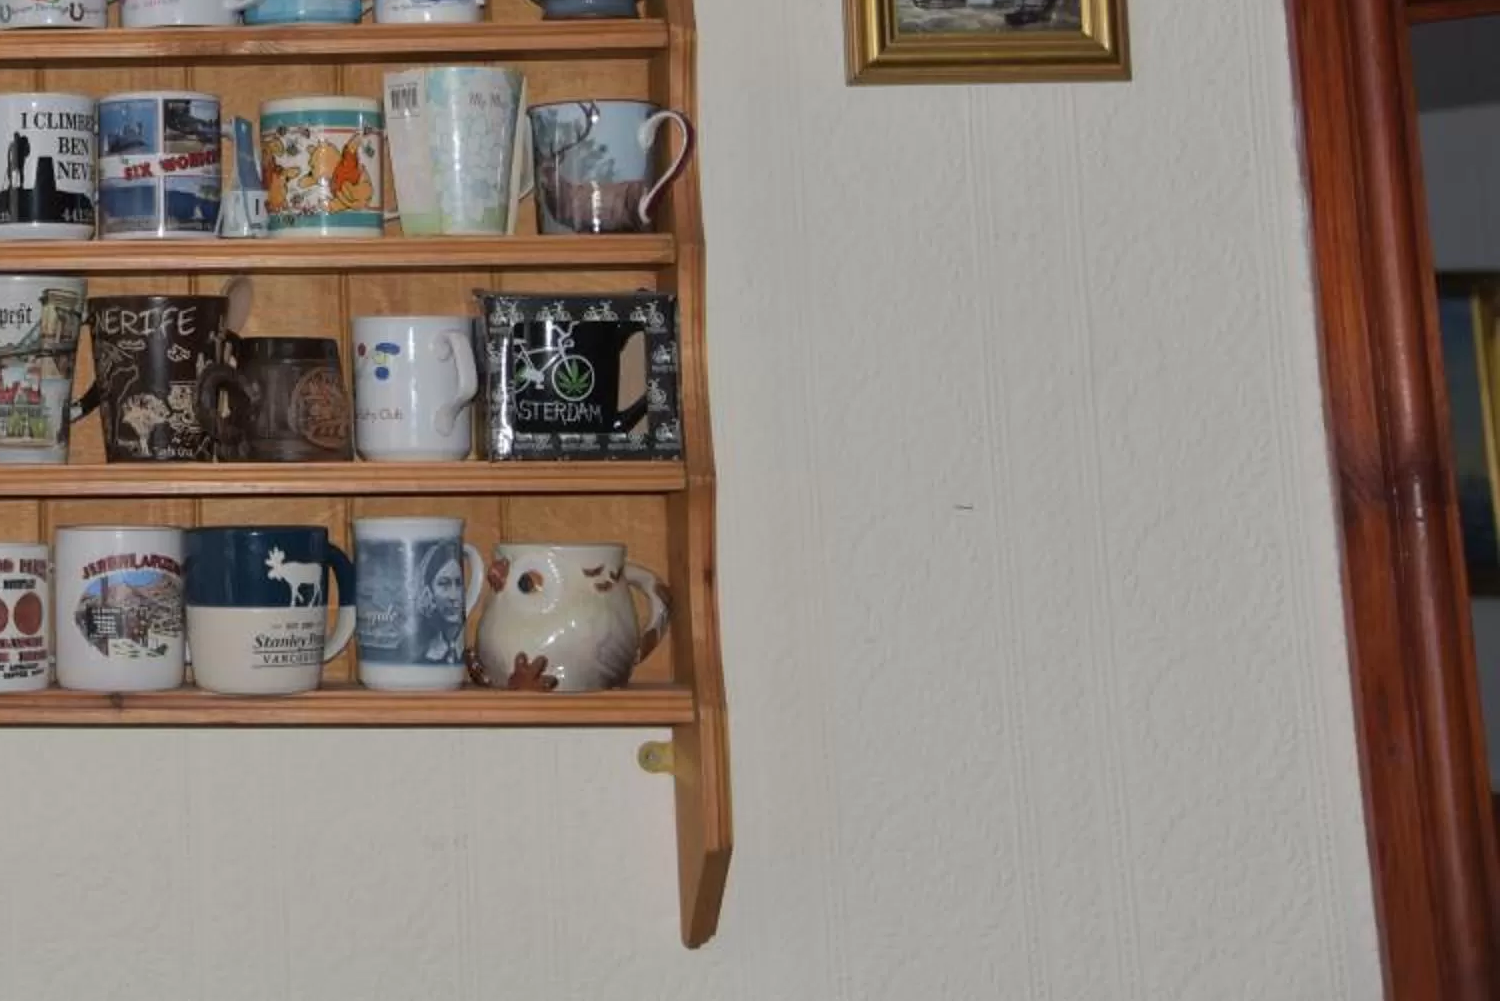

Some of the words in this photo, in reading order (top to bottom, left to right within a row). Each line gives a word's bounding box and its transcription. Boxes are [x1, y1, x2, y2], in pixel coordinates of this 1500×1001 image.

[33, 111, 98, 133] CLIMBE
[57, 160, 90, 180] NEV
[518, 401, 603, 424] STERDAM
[252, 633, 306, 649] Stanley
